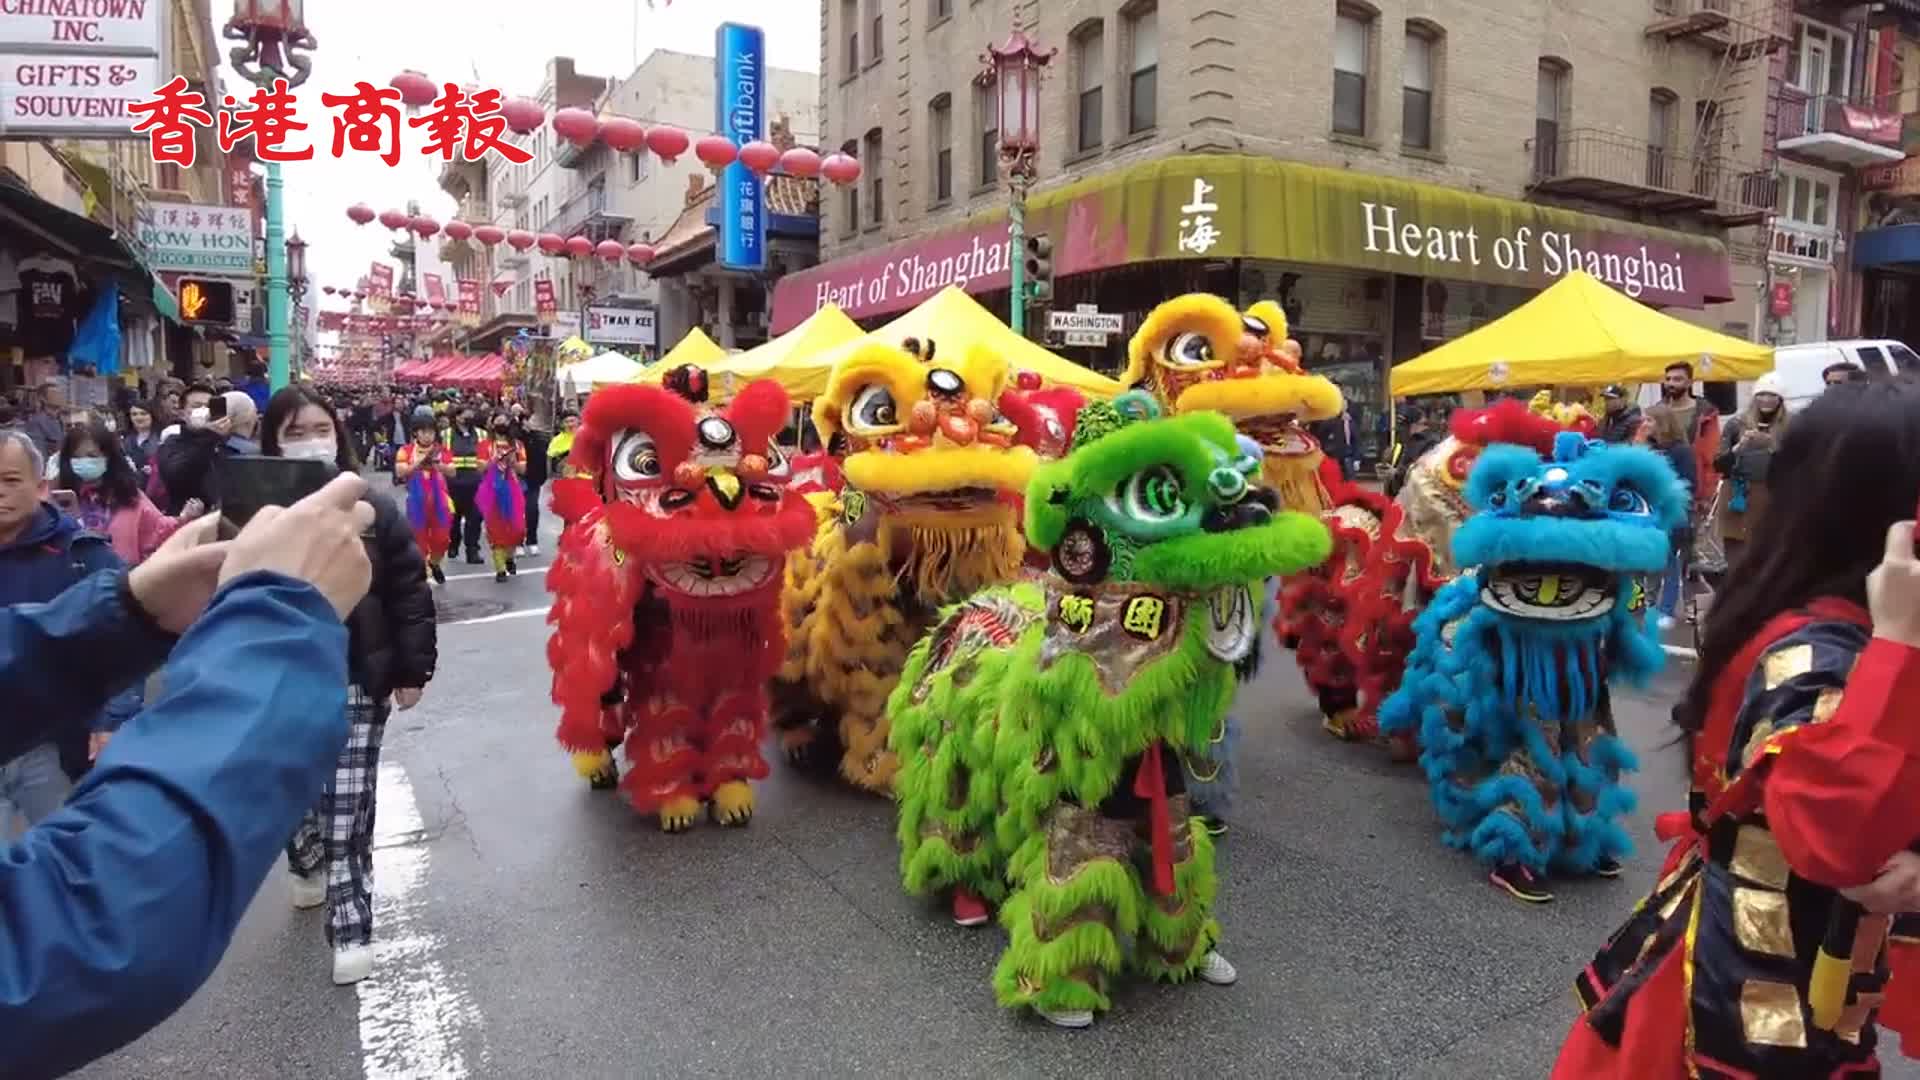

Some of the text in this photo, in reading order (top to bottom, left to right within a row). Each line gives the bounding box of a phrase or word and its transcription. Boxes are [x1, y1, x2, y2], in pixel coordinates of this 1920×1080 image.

[1, 0, 145, 20] CHINATOWN
[52, 21, 105, 42] INC.
[16, 64, 138, 87] GIFTS &
[730, 52, 757, 149] citibank
[1179, 177, 1220, 254] 上海
[141, 230, 249, 249] BOW HON
[1361, 202, 1686, 298] Heart of Shanghai
[816, 224, 1013, 312] Heart of Shanghai
[603, 314, 630, 326] TWAN
[635, 315, 652, 328] KEE
[1053, 315, 1120, 329] WASHINGTON
